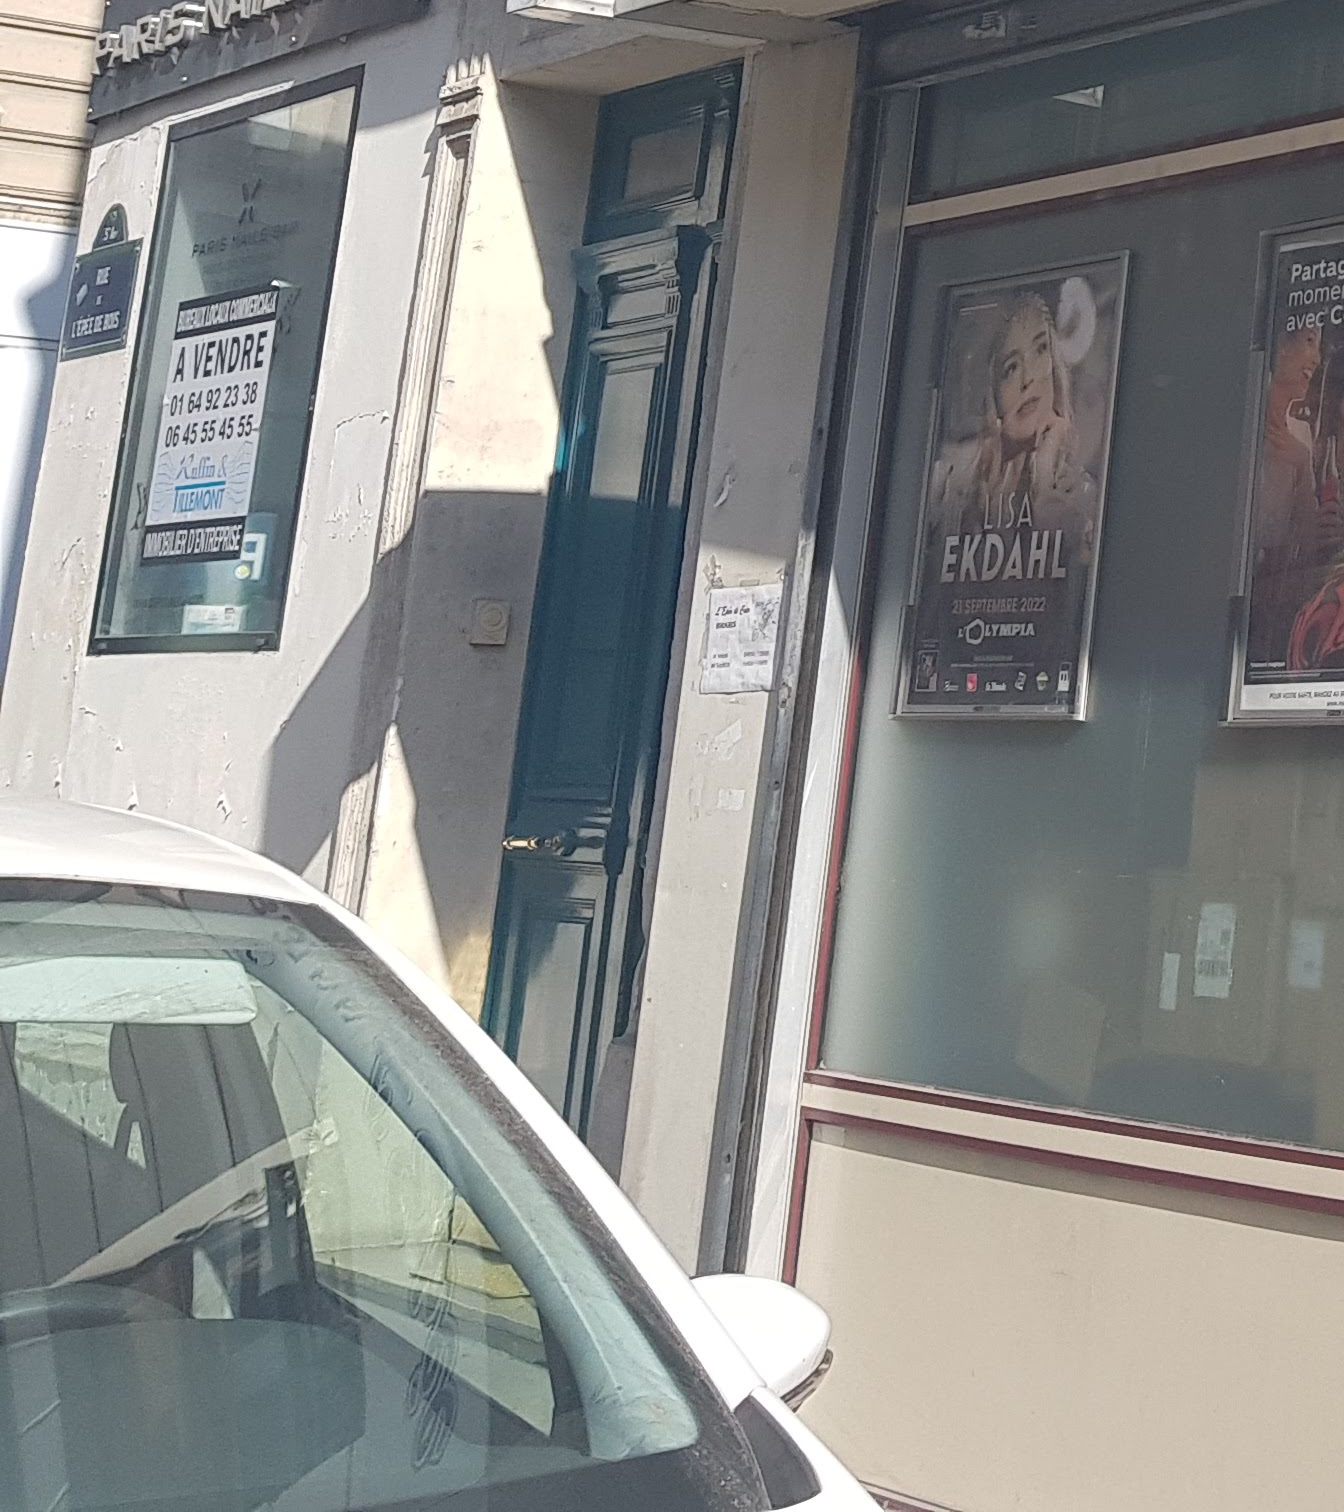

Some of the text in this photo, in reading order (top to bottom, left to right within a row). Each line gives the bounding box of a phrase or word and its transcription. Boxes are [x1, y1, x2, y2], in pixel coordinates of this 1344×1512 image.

[95, 1, 204, 70] PARIS
[1286, 309, 1326, 332] avec
[173, 330, 268, 383] A VENDRE
[170, 382, 258, 416] 01 64 92 23 38
[165, 414, 253, 447] 06 45 55 45 55
[984, 492, 1033, 529] LISA
[941, 530, 1066, 583] EKDAHL
[964, 598, 1018, 614] SEPTEMBRE
[1020, 597, 1046, 612] 2022
